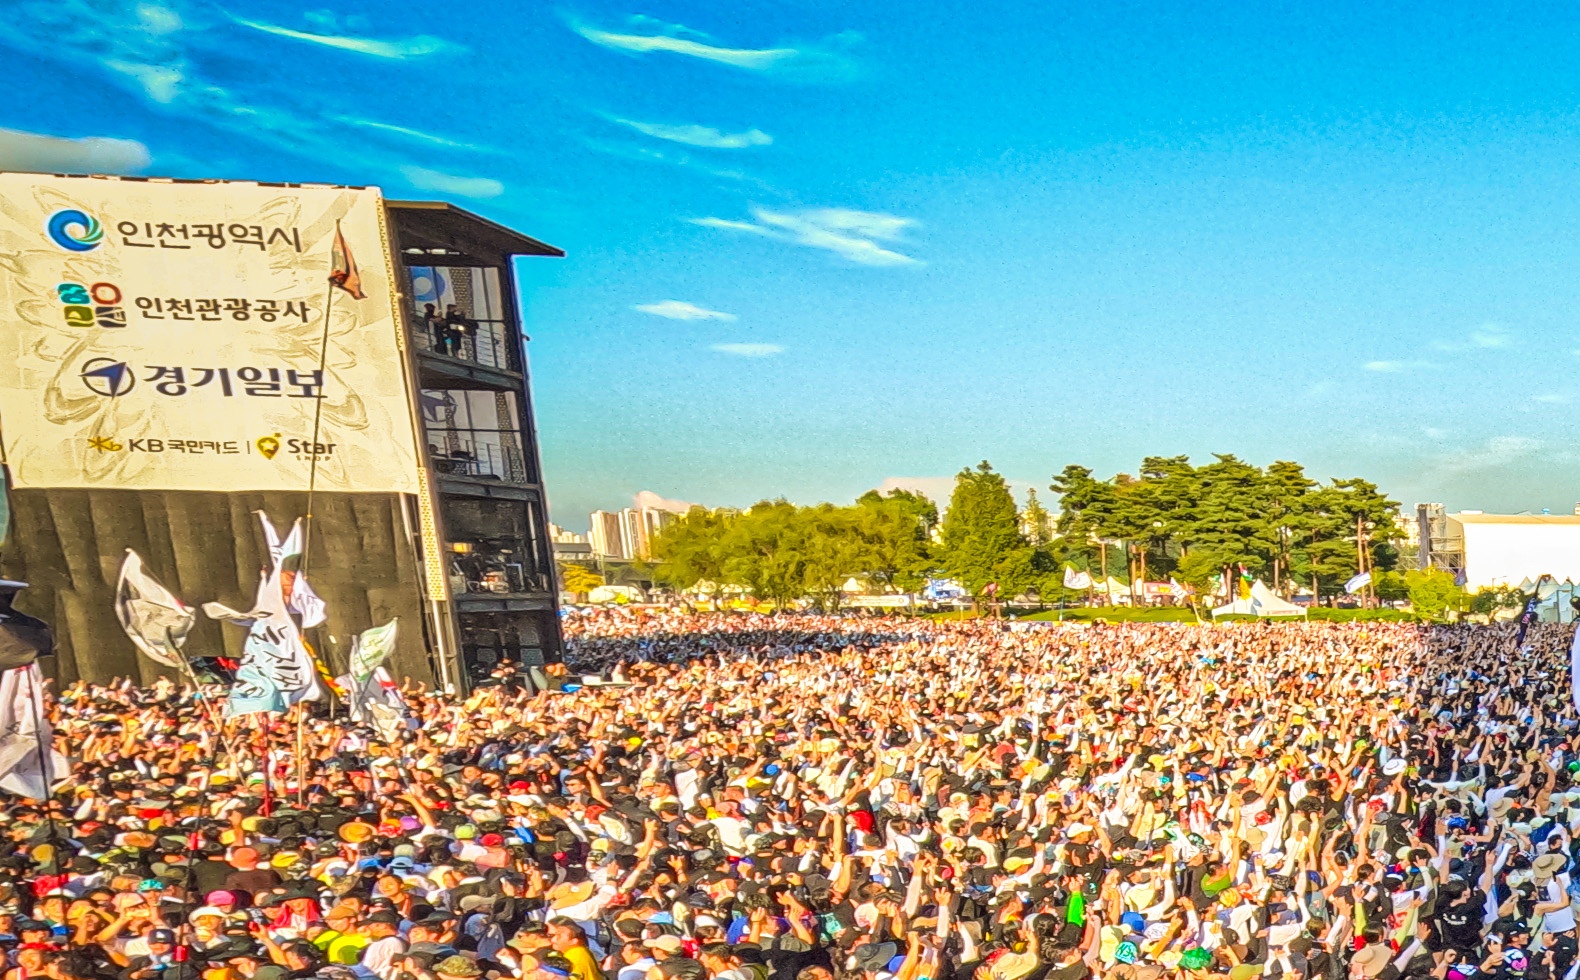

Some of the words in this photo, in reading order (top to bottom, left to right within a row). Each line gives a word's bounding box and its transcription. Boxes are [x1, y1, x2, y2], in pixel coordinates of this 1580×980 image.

[117, 221, 302, 252] 인천광역시
[135, 297, 311, 323] 인천관광공사
[144, 366, 328, 398] 경기일보
[287, 439, 337, 454] Star
